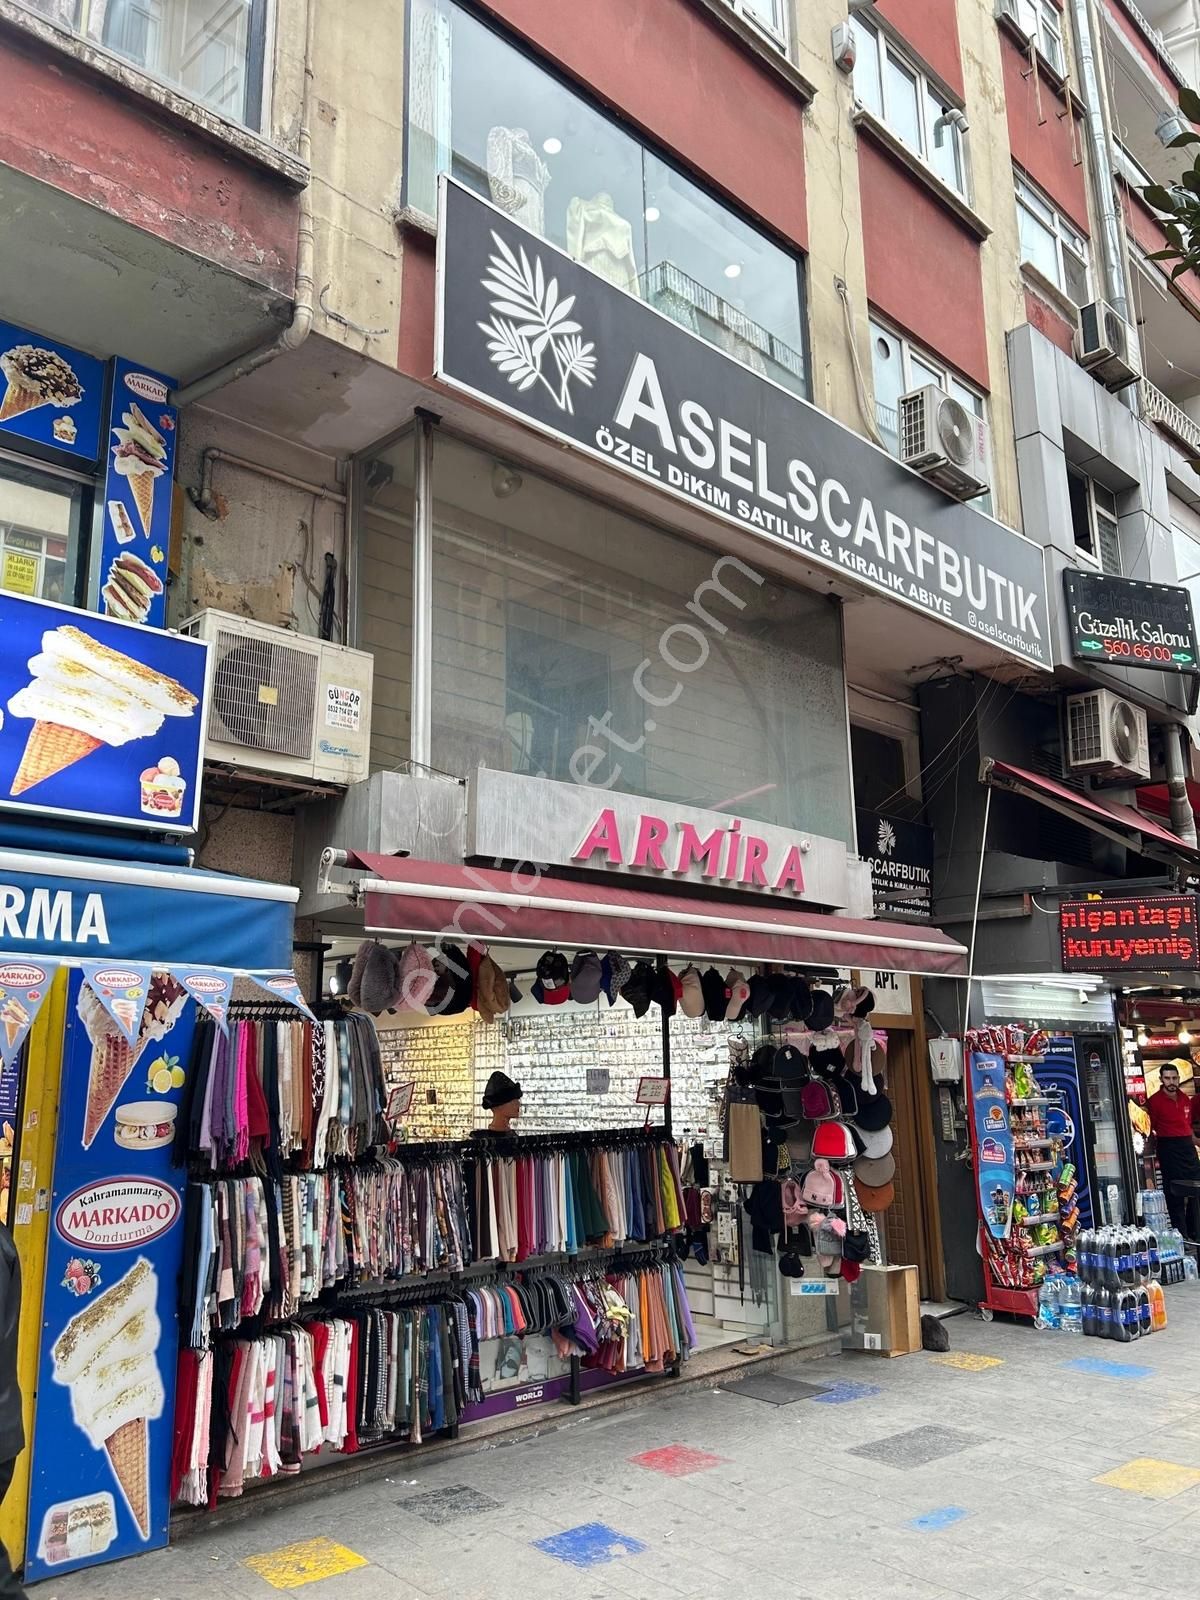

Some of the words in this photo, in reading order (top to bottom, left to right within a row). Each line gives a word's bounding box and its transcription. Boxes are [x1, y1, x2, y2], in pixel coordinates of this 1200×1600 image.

[595, 425, 661, 477] ÖZEL
[737, 498, 815, 549] SATILIK
[820, 538, 833, 558] &
[612, 351, 1042, 640] ASELSCARFBUTIK
[1141, 621, 1191, 648] Salonu
[1103, 639, 1130, 656] 560
[1133, 643, 1152, 659] 66
[1153, 646, 1171, 661] 00
[328, 687, 360, 706] GÜNGÖR
[570, 808, 805, 894] ARMİRA
[0, 884, 110, 944] RMA
[875, 971, 899, 990] APT.
[79, 1187, 163, 1208] Kahramanmaraş
[68, 1202, 170, 1229] MARKADO
[84, 1224, 153, 1243] Dondurma
[515, 1390, 543, 1402] WORLD
